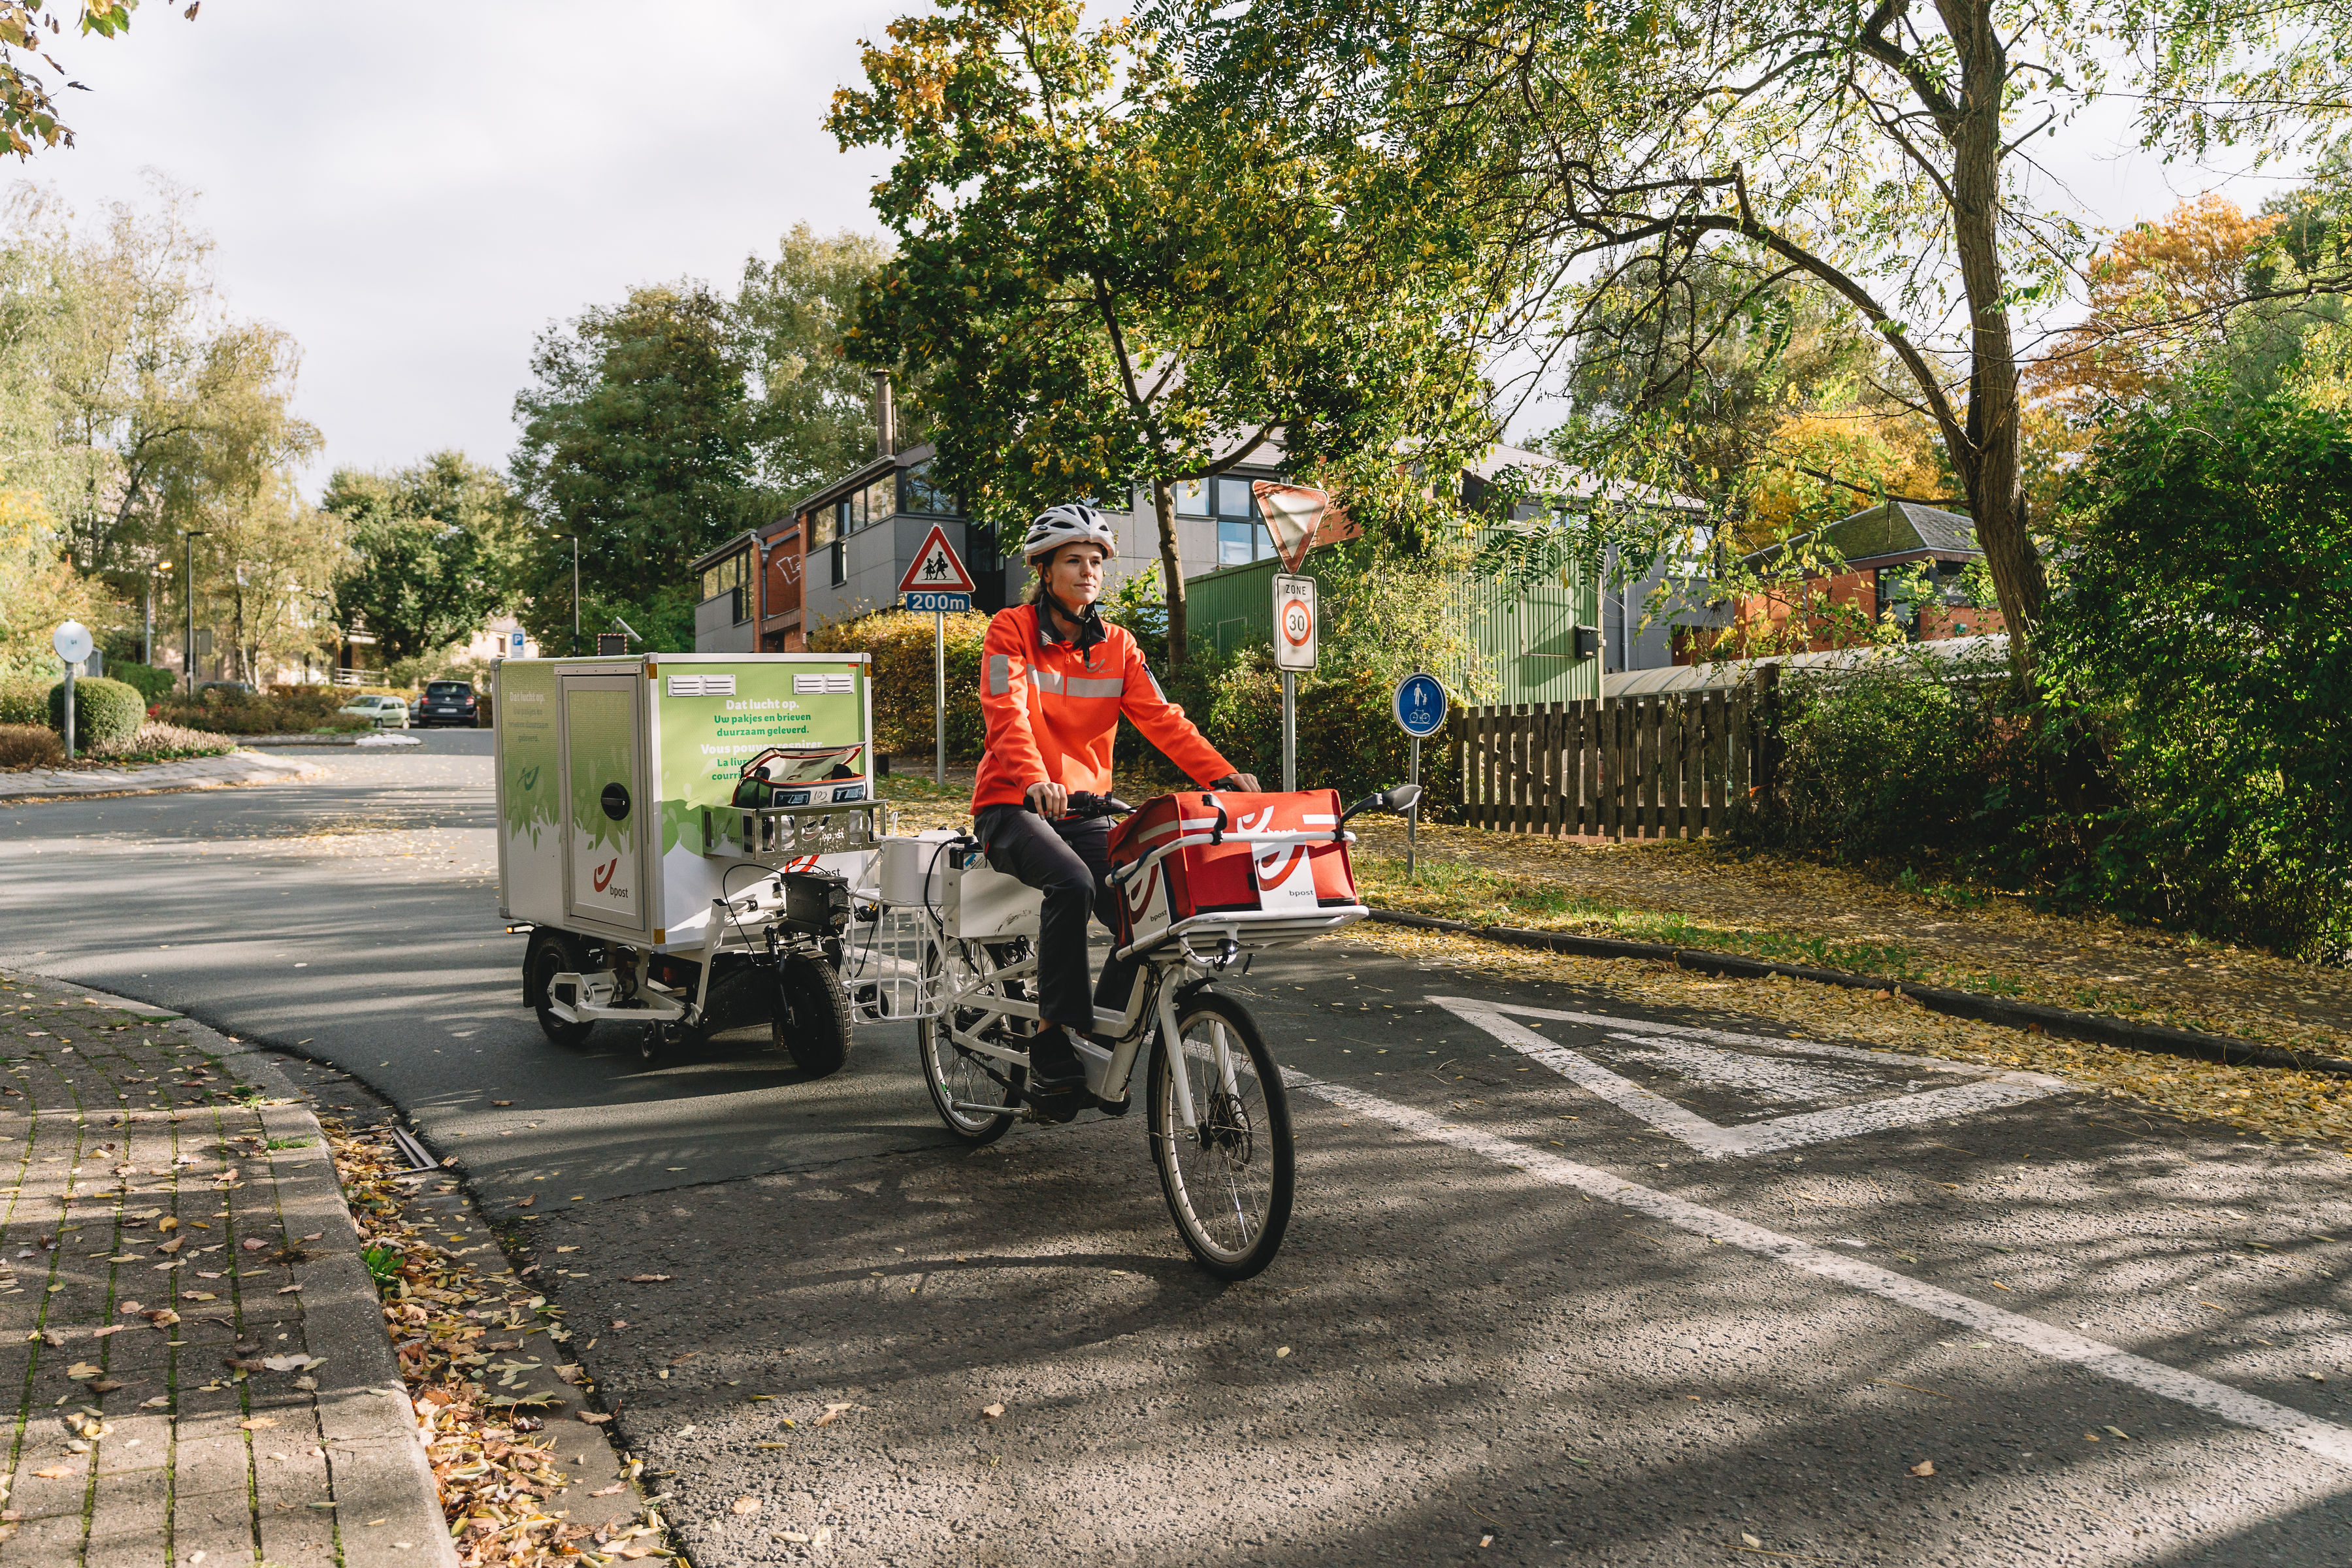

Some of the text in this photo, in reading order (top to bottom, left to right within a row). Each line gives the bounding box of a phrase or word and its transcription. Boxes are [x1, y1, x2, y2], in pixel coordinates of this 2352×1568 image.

[1286, 584, 1306, 595] ZONE
[912, 594, 964, 610] 200m
[1290, 614, 1305, 631] 30
[514, 635, 521, 644] P
[510, 691, 520, 702] Dat
[521, 691, 535, 702] lucht
[726, 698, 800, 711] Dat lucht op.
[731, 714, 762, 725] pakjes
[777, 713, 811, 721] brieven
[717, 725, 809, 737] duurzaam geleverd.
[700, 743, 730, 755] Vous
[717, 759, 728, 767] La
[814, 791, 828, 800] 103
[610, 884, 629, 898] bpost
[1150, 909, 1167, 922] bpost
